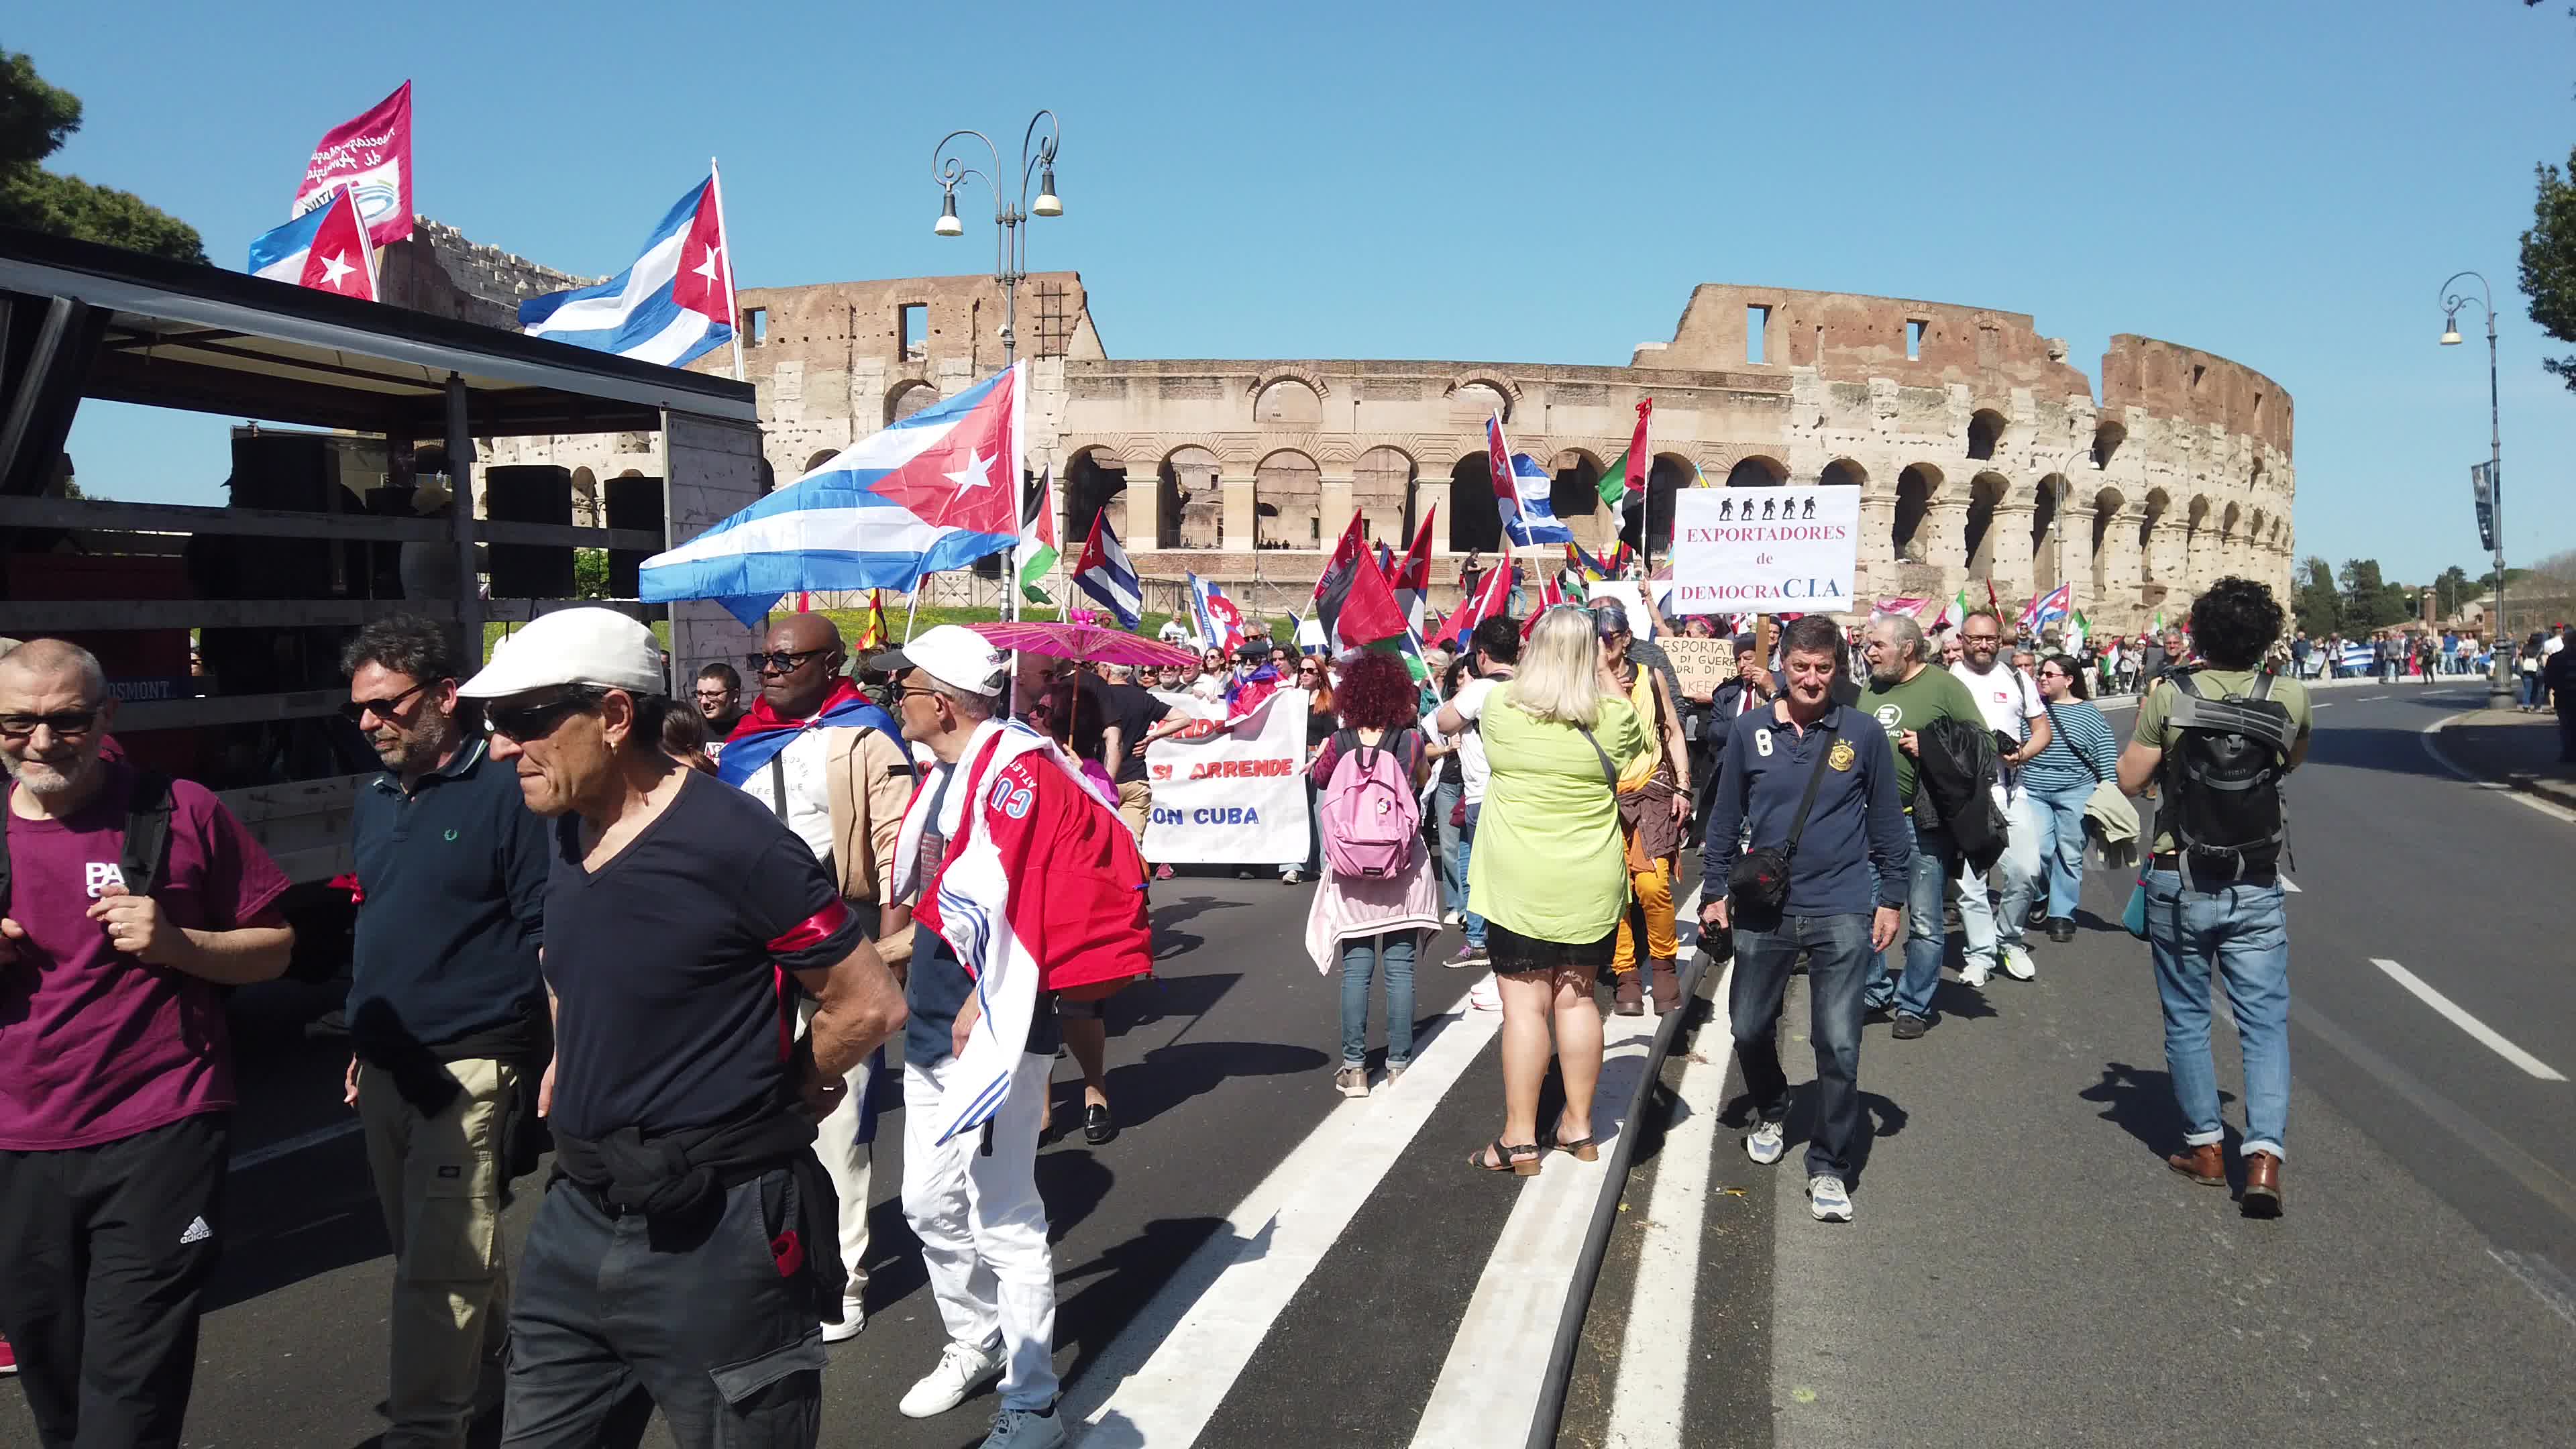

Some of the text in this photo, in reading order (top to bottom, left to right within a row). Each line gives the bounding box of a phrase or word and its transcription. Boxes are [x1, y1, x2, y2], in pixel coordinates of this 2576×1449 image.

[1687, 526, 1845, 543] EXPORTADORES
[1756, 553, 1773, 564] de
[1663, 640, 1733, 655] ESPORTAT
[1680, 655, 1736, 666] DI GUERR
[1705, 665, 1715, 675] DI
[1725, 668, 1737, 677] TE
[1756, 729, 1773, 756] 8
[1152, 759, 1293, 780] SI ARRENDE
[991, 773, 1033, 819] CU
[1193, 808, 1259, 824] CUBA
[86, 863, 125, 885] PA
